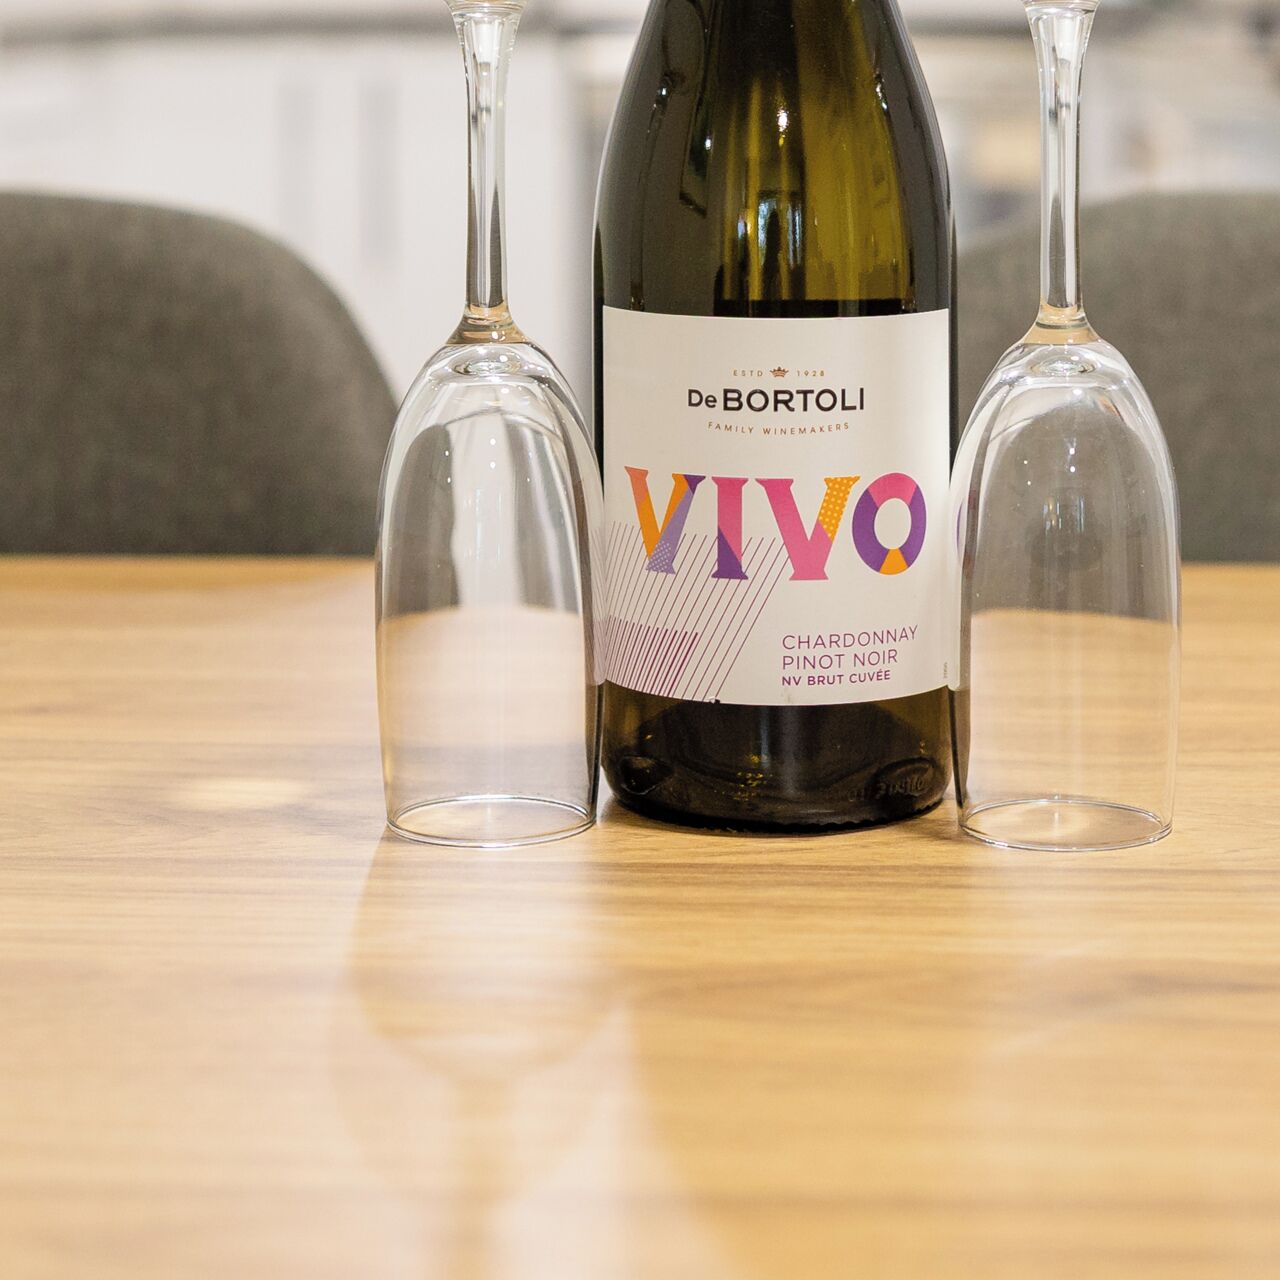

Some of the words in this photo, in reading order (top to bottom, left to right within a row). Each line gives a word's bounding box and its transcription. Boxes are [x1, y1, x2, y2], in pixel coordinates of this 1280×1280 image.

[733, 369, 763, 377] ESTD
[796, 369, 825, 377] 1928
[707, 421, 755, 434] FAMILY
[763, 422, 851, 435] WINEMAKERS
[624, 465, 928, 581] VIVO
[782, 624, 919, 650] CHARDONNAY
[782, 653, 846, 670] PINOT
[853, 648, 899, 668] NOIR
[782, 676, 802, 686] NV
[807, 674, 845, 686] BRUT
[849, 669, 892, 684] CUVÉE
